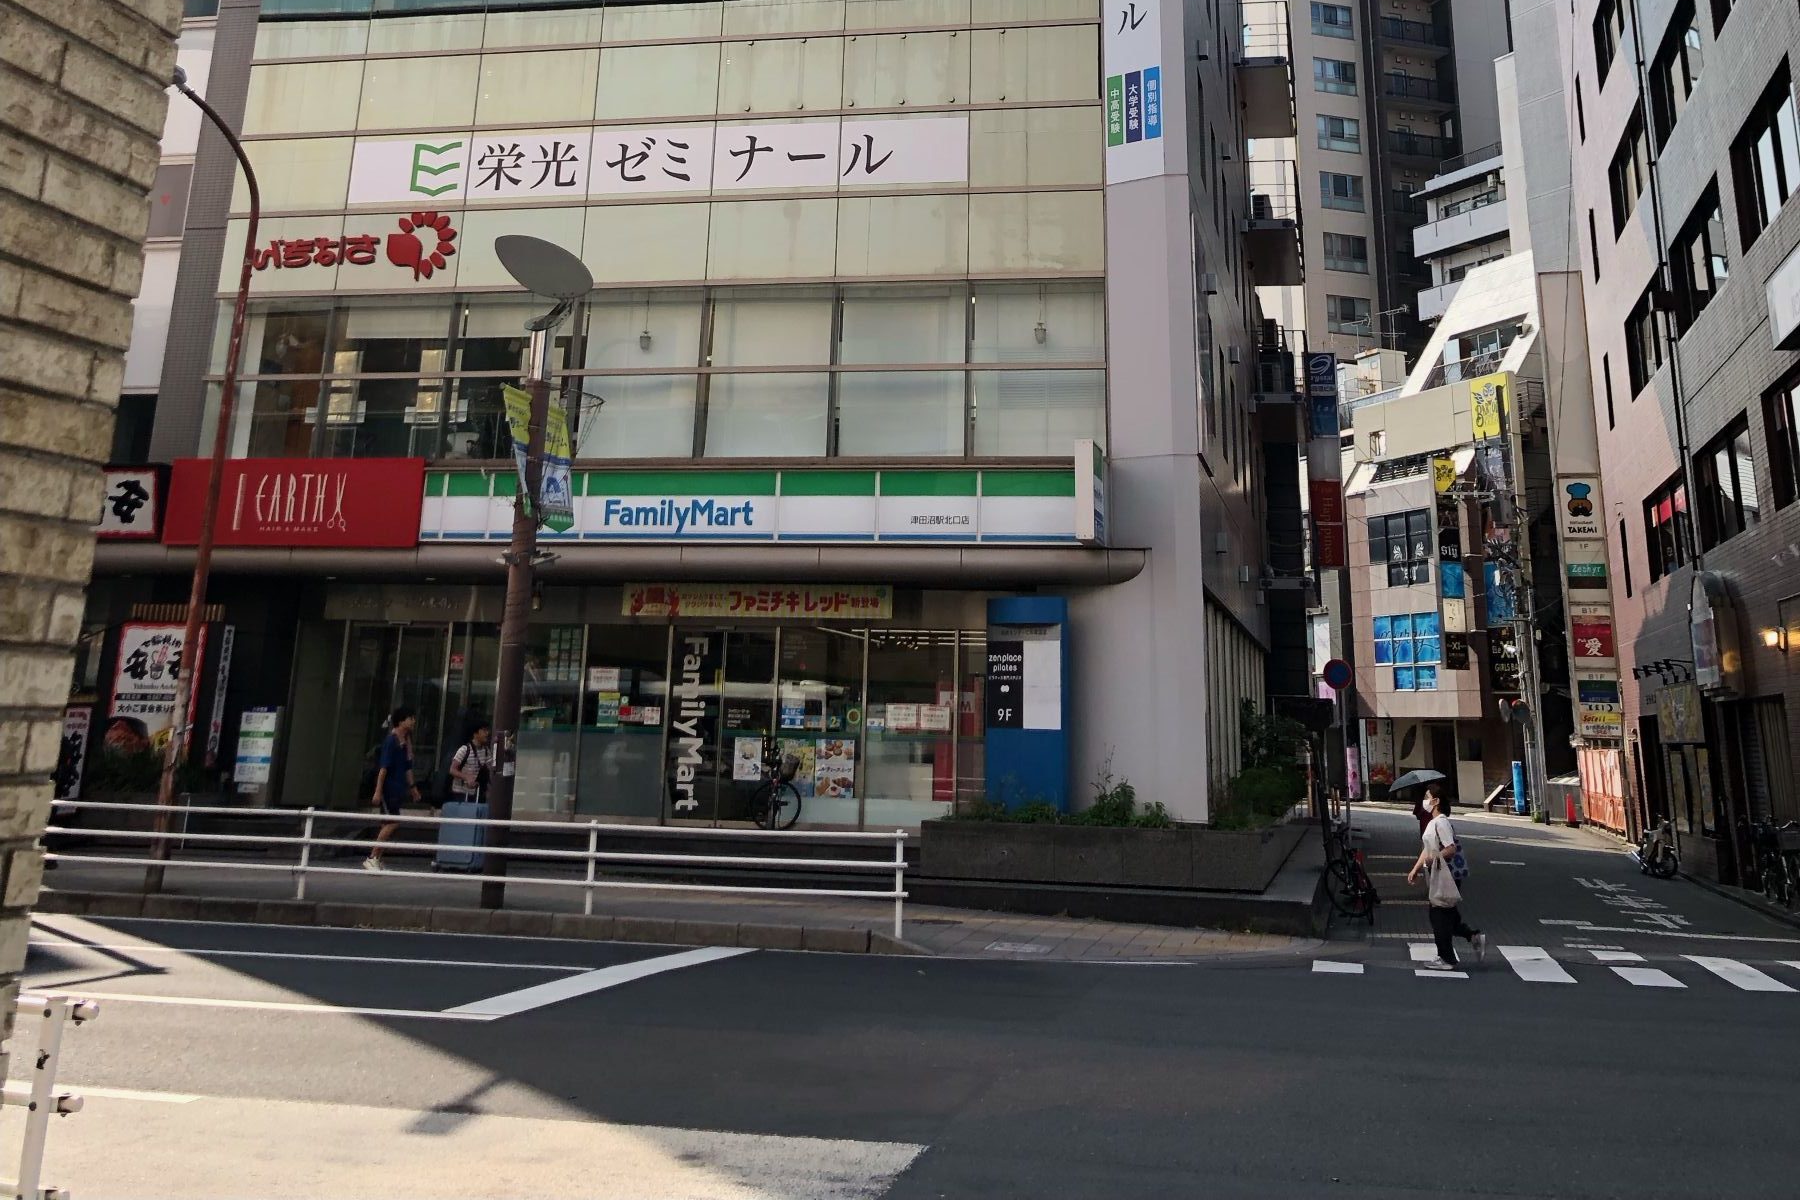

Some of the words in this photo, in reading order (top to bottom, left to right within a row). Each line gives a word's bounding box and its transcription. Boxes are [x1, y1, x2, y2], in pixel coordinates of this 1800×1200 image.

[1127, 83, 1140, 132] 大学受験
[1146, 79, 1159, 136] 個別指導
[476, 133, 894, 191] 栄光ゼミナール
[256, 473, 327, 523] EARTH
[603, 498, 754, 534] FamilyMart
[910, 515, 970, 526] 津田沼駅北口店
[1567, 526, 1598, 534] TAKEMI
[1584, 637, 1604, 656] 愛
[992, 663, 1018, 673] pilates
[674, 636, 710, 812] FamilyMart
[997, 708, 1013, 721] 9F
